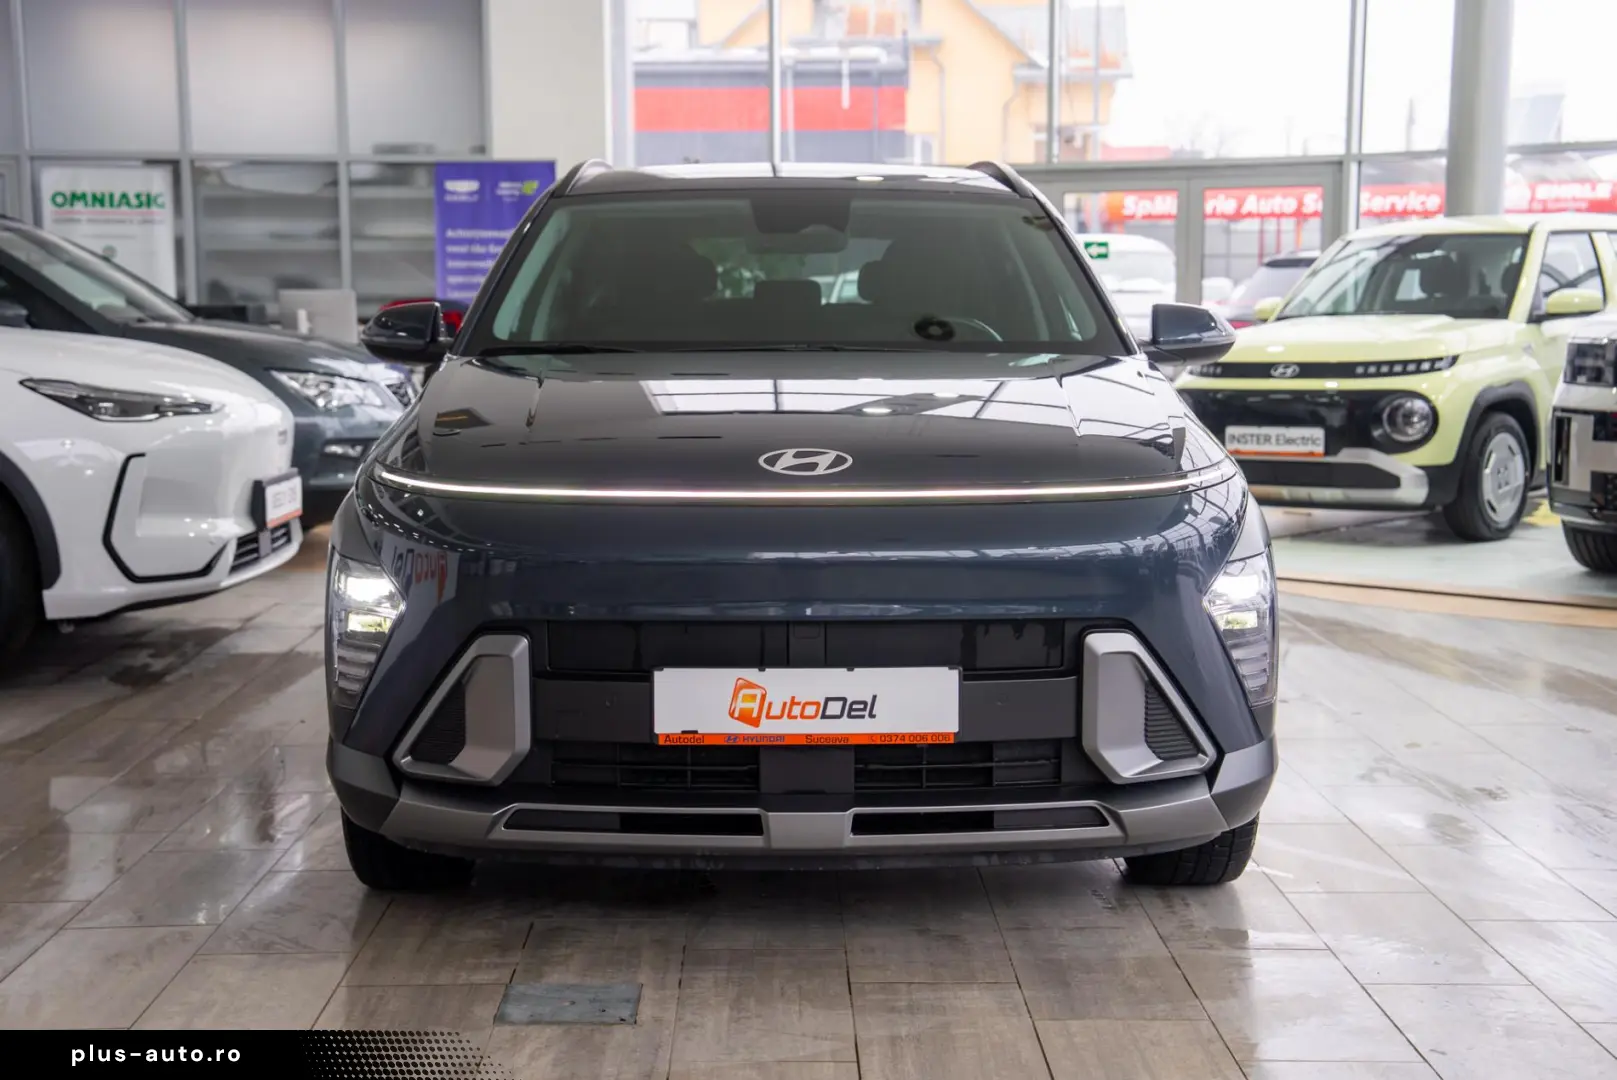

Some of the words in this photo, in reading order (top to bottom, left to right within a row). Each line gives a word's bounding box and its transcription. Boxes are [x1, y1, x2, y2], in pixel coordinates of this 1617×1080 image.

[1241, 192, 1297, 213] Auto
[1360, 191, 1441, 212] Service
[1227, 432, 1273, 446] INSTER
[1275, 433, 1322, 447] Electric
[729, 677, 878, 728] AutoDel
[664, 734, 705, 744] Autodel
[743, 735, 785, 743] HYUNDAI
[805, 734, 850, 744] Suceava
[879, 734, 906, 743] 0374
[909, 733, 928, 742] 006
